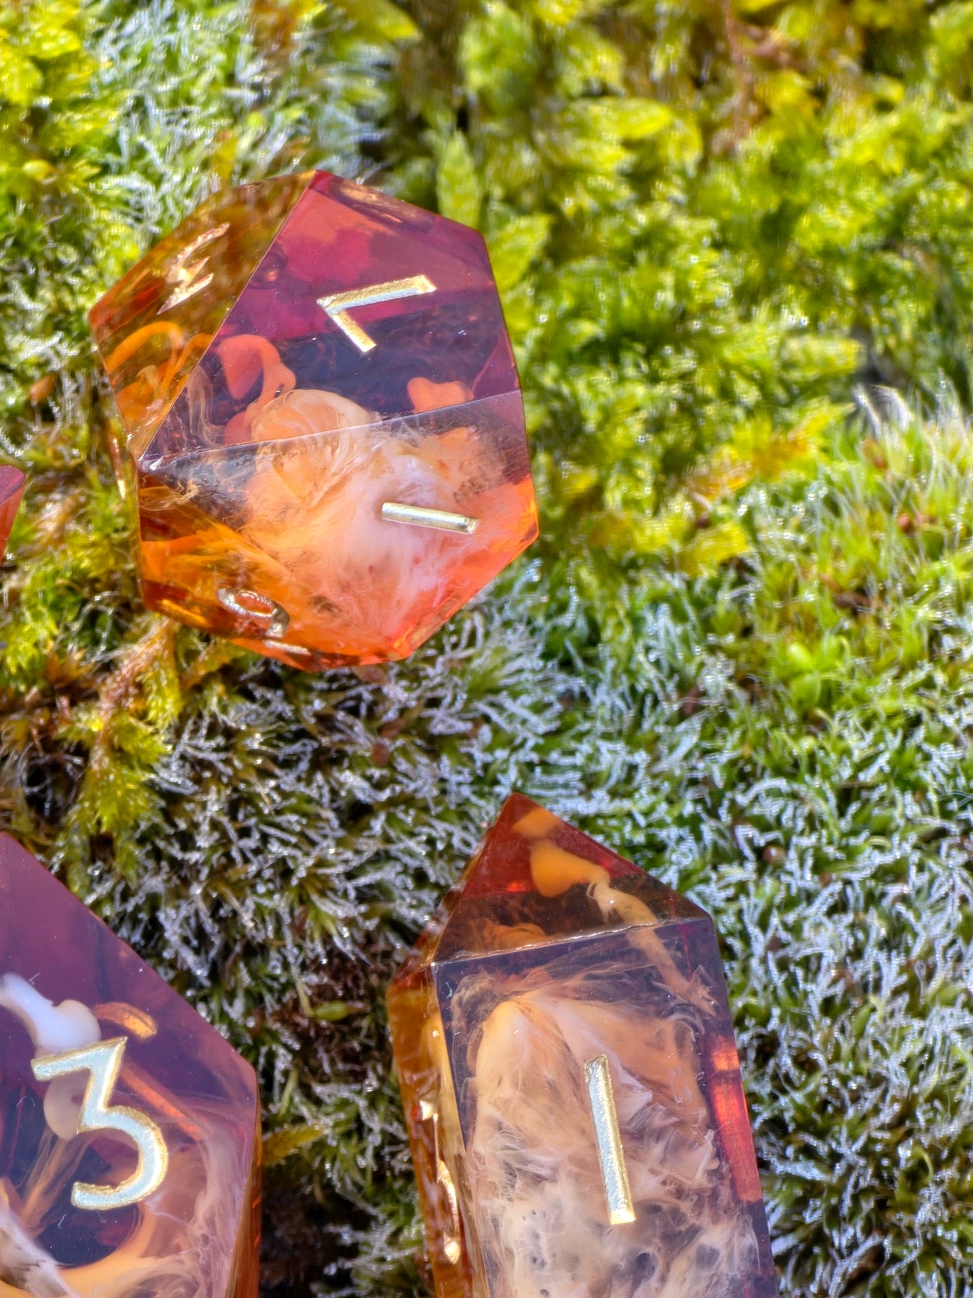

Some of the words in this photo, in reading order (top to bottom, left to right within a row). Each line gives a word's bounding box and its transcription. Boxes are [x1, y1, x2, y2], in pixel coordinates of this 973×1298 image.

[317, 274, 438, 353] 7
[382, 502, 481, 535] 1
[30, 1036, 169, 1211] 3
[584, 1053, 636, 1225] 1
